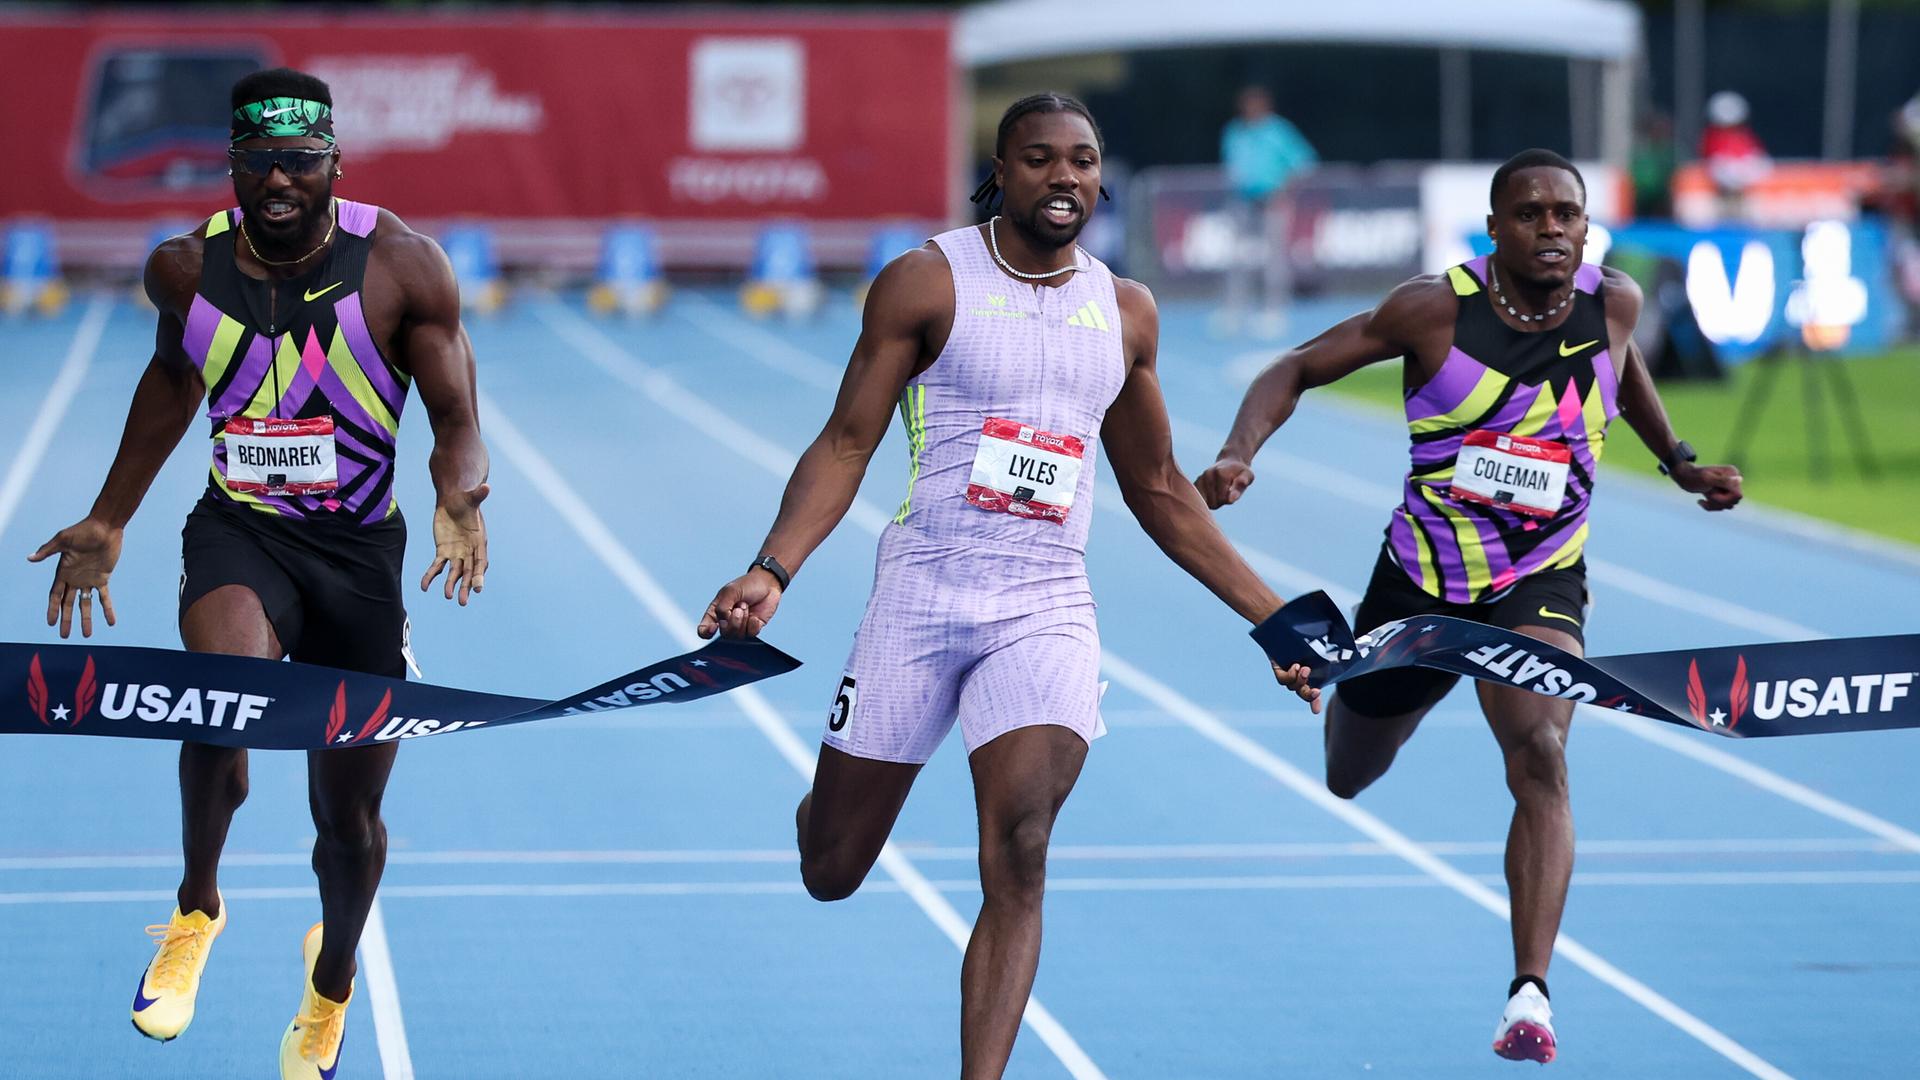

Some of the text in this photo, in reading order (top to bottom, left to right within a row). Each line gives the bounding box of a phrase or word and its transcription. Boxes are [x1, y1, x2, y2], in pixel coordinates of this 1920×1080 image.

[267, 423, 298, 432] TOYOTA
[1035, 435, 1064, 447] TOYOTA
[238, 445, 321, 467] BEDNAREK
[1512, 443, 1542, 453] TOYOTA
[1008, 454, 1057, 485] LYLES
[1474, 457, 1550, 491] COLEMAN
[1464, 643, 1597, 703] USATF
[99, 683, 270, 731] USATF
[829, 676, 856, 732] 5
[1753, 673, 1912, 720] USATF
